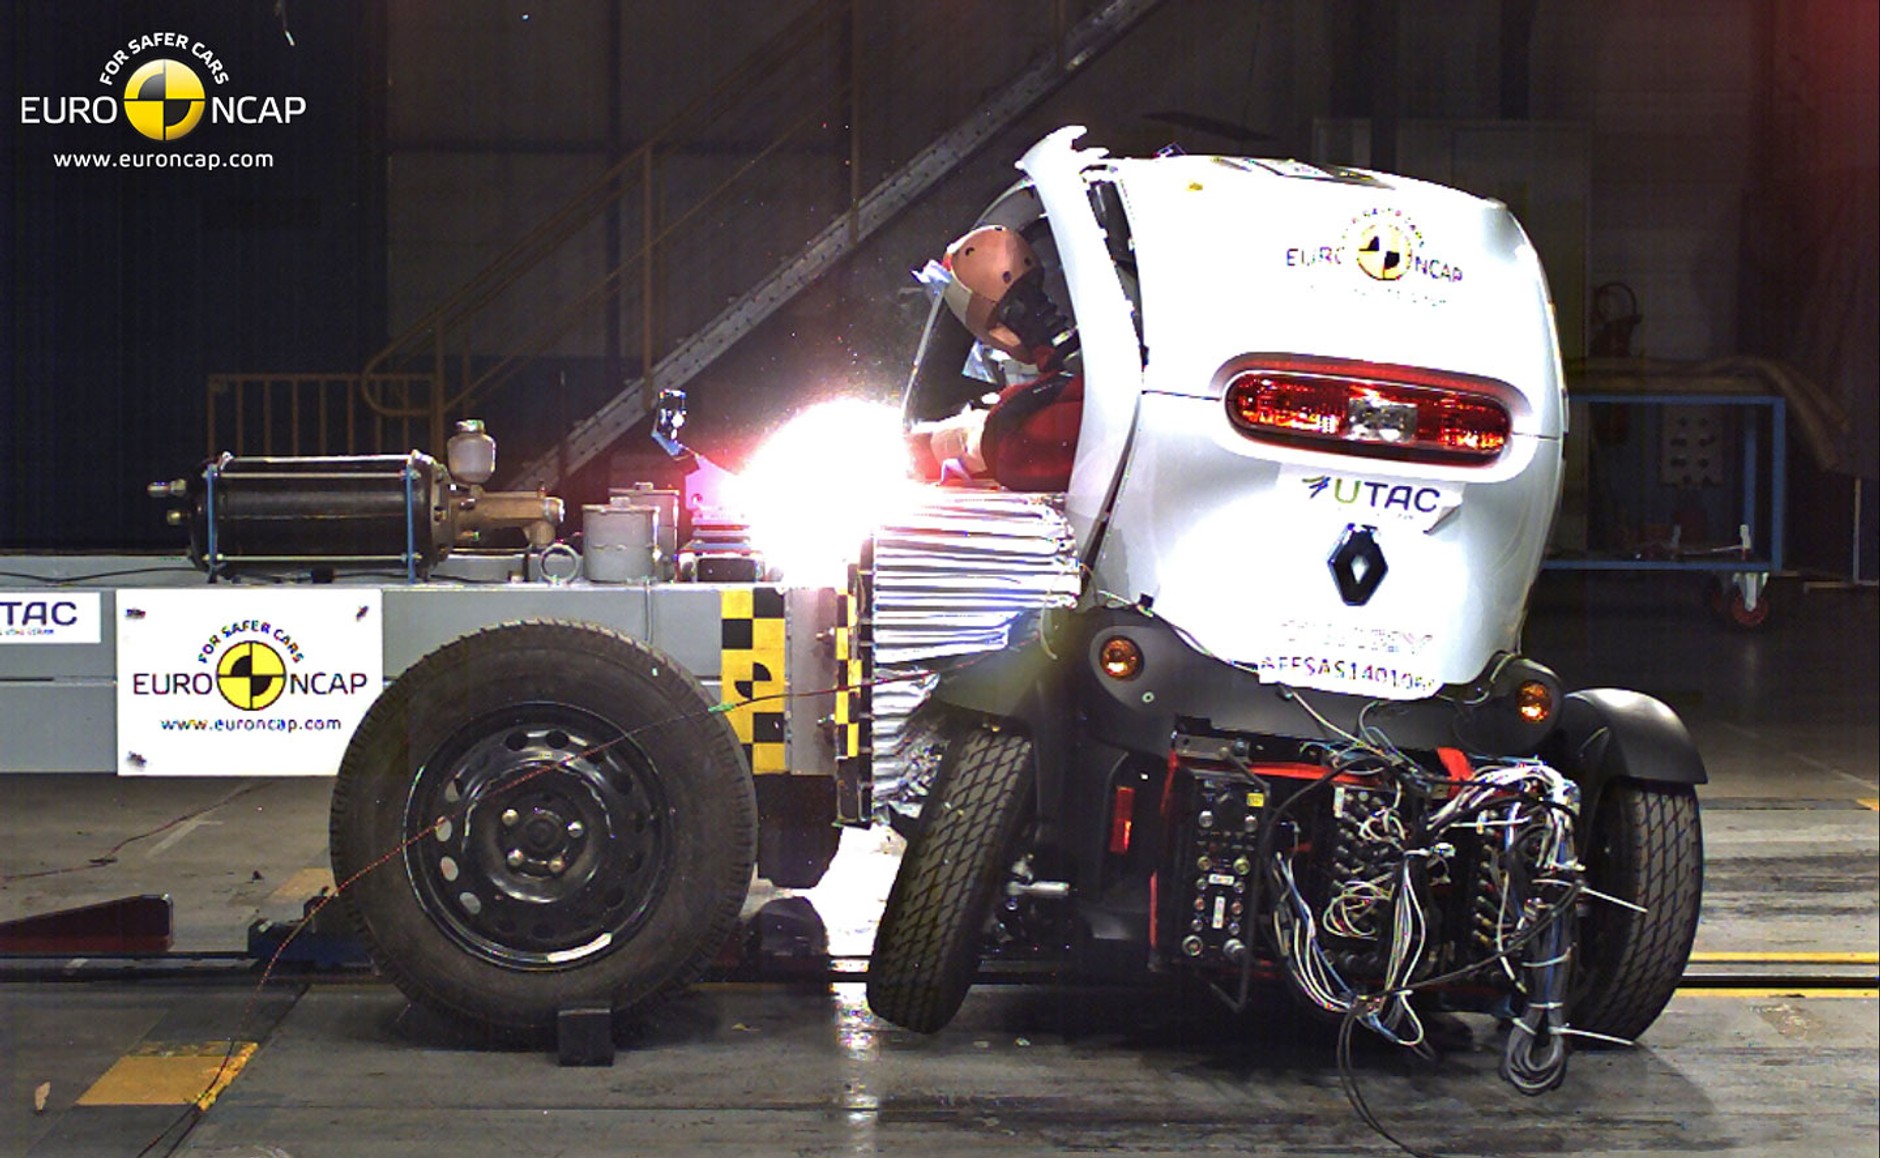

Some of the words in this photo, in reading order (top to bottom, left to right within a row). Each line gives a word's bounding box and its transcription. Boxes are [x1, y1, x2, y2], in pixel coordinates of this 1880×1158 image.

[1415, 256, 1463, 282] NCAP
[1334, 477, 1441, 512] UTAC
[0, 601, 78, 627] TAC
[198, 634, 221, 664] FOR
[221, 619, 271, 638] SAFER
[273, 628, 305, 664] CARS
[133, 672, 213, 695] EURO
[289, 672, 368, 695] NCAP
[160, 718, 342, 733] www.euroncap.com
